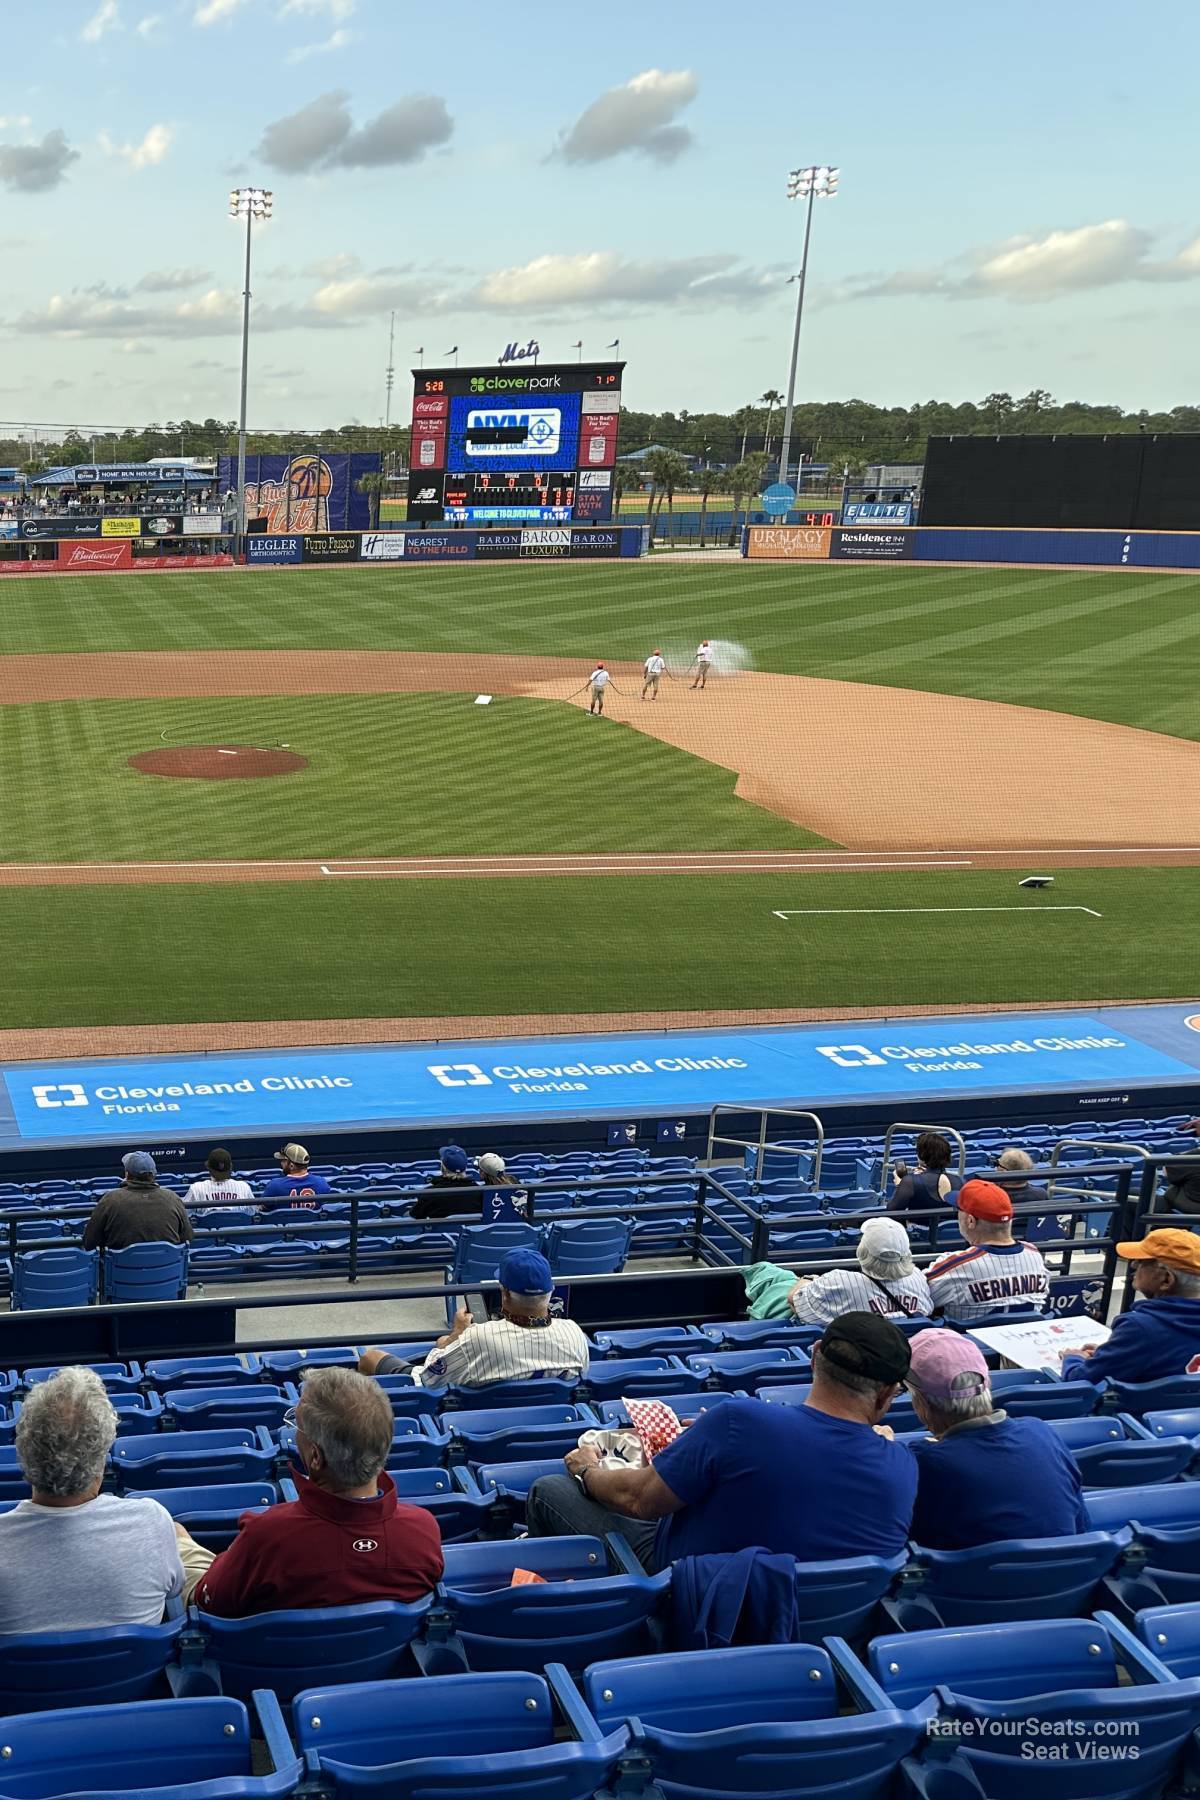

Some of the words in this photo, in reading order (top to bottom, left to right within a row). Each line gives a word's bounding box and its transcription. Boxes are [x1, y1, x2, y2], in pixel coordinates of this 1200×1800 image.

[498, 339, 540, 363] Mets
[425, 381, 444, 392] 5:28
[473, 510, 499, 518] WELCOME
[578, 509, 592, 517] US.
[847, 505, 907, 517] ELITE
[407, 537, 449, 547] NEAREST
[479, 536, 519, 544] BARON
[522, 529, 571, 544] BARON
[573, 534, 614, 543] BARON
[840, 533, 892, 542] Residence
[249, 539, 297, 551] LEGLER
[407, 546, 420, 554] TO
[421, 546, 440, 554] THE
[441, 545, 468, 554] FIELD
[525, 546, 566, 555] LUXURY
[75, 549, 119, 560] Budweiser
[881, 1040, 1037, 1060] Cleveland
[1032, 1036, 1127, 1052] Clinic
[492, 1060, 655, 1080] Cleveland
[654, 1056, 749, 1072] Clinic
[904, 1060, 985, 1074] Florida
[95, 1079, 257, 1101] Cleveland
[259, 1074, 354, 1092] Clinic
[508, 1081, 590, 1094] Florida
[102, 1101, 182, 1116] Florida
[613, 1131, 620, 1139] 7
[663, 1128, 669, 1136] 6
[492, 1209, 501, 1220] 7
[1037, 1216, 1047, 1228] 7
[1048, 1294, 1079, 1309] 107
